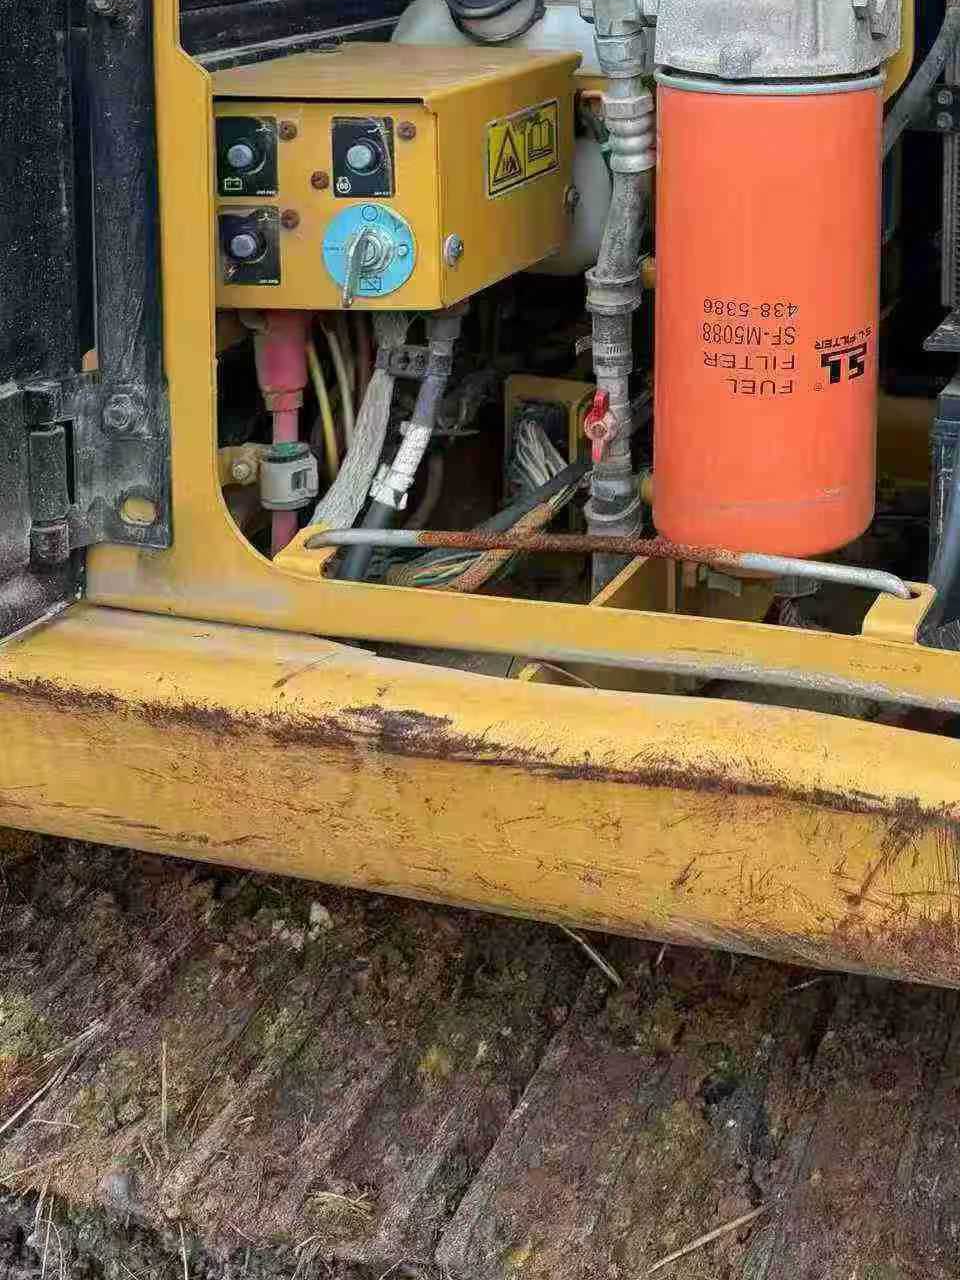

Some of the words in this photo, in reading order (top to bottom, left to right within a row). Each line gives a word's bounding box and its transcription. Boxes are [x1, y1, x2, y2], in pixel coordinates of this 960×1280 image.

[703, 298, 799, 318] 438-5386
[702, 322, 796, 346] SF-M5088
[703, 352, 795, 370] FILTER
[721, 378, 794, 395] FUEL
